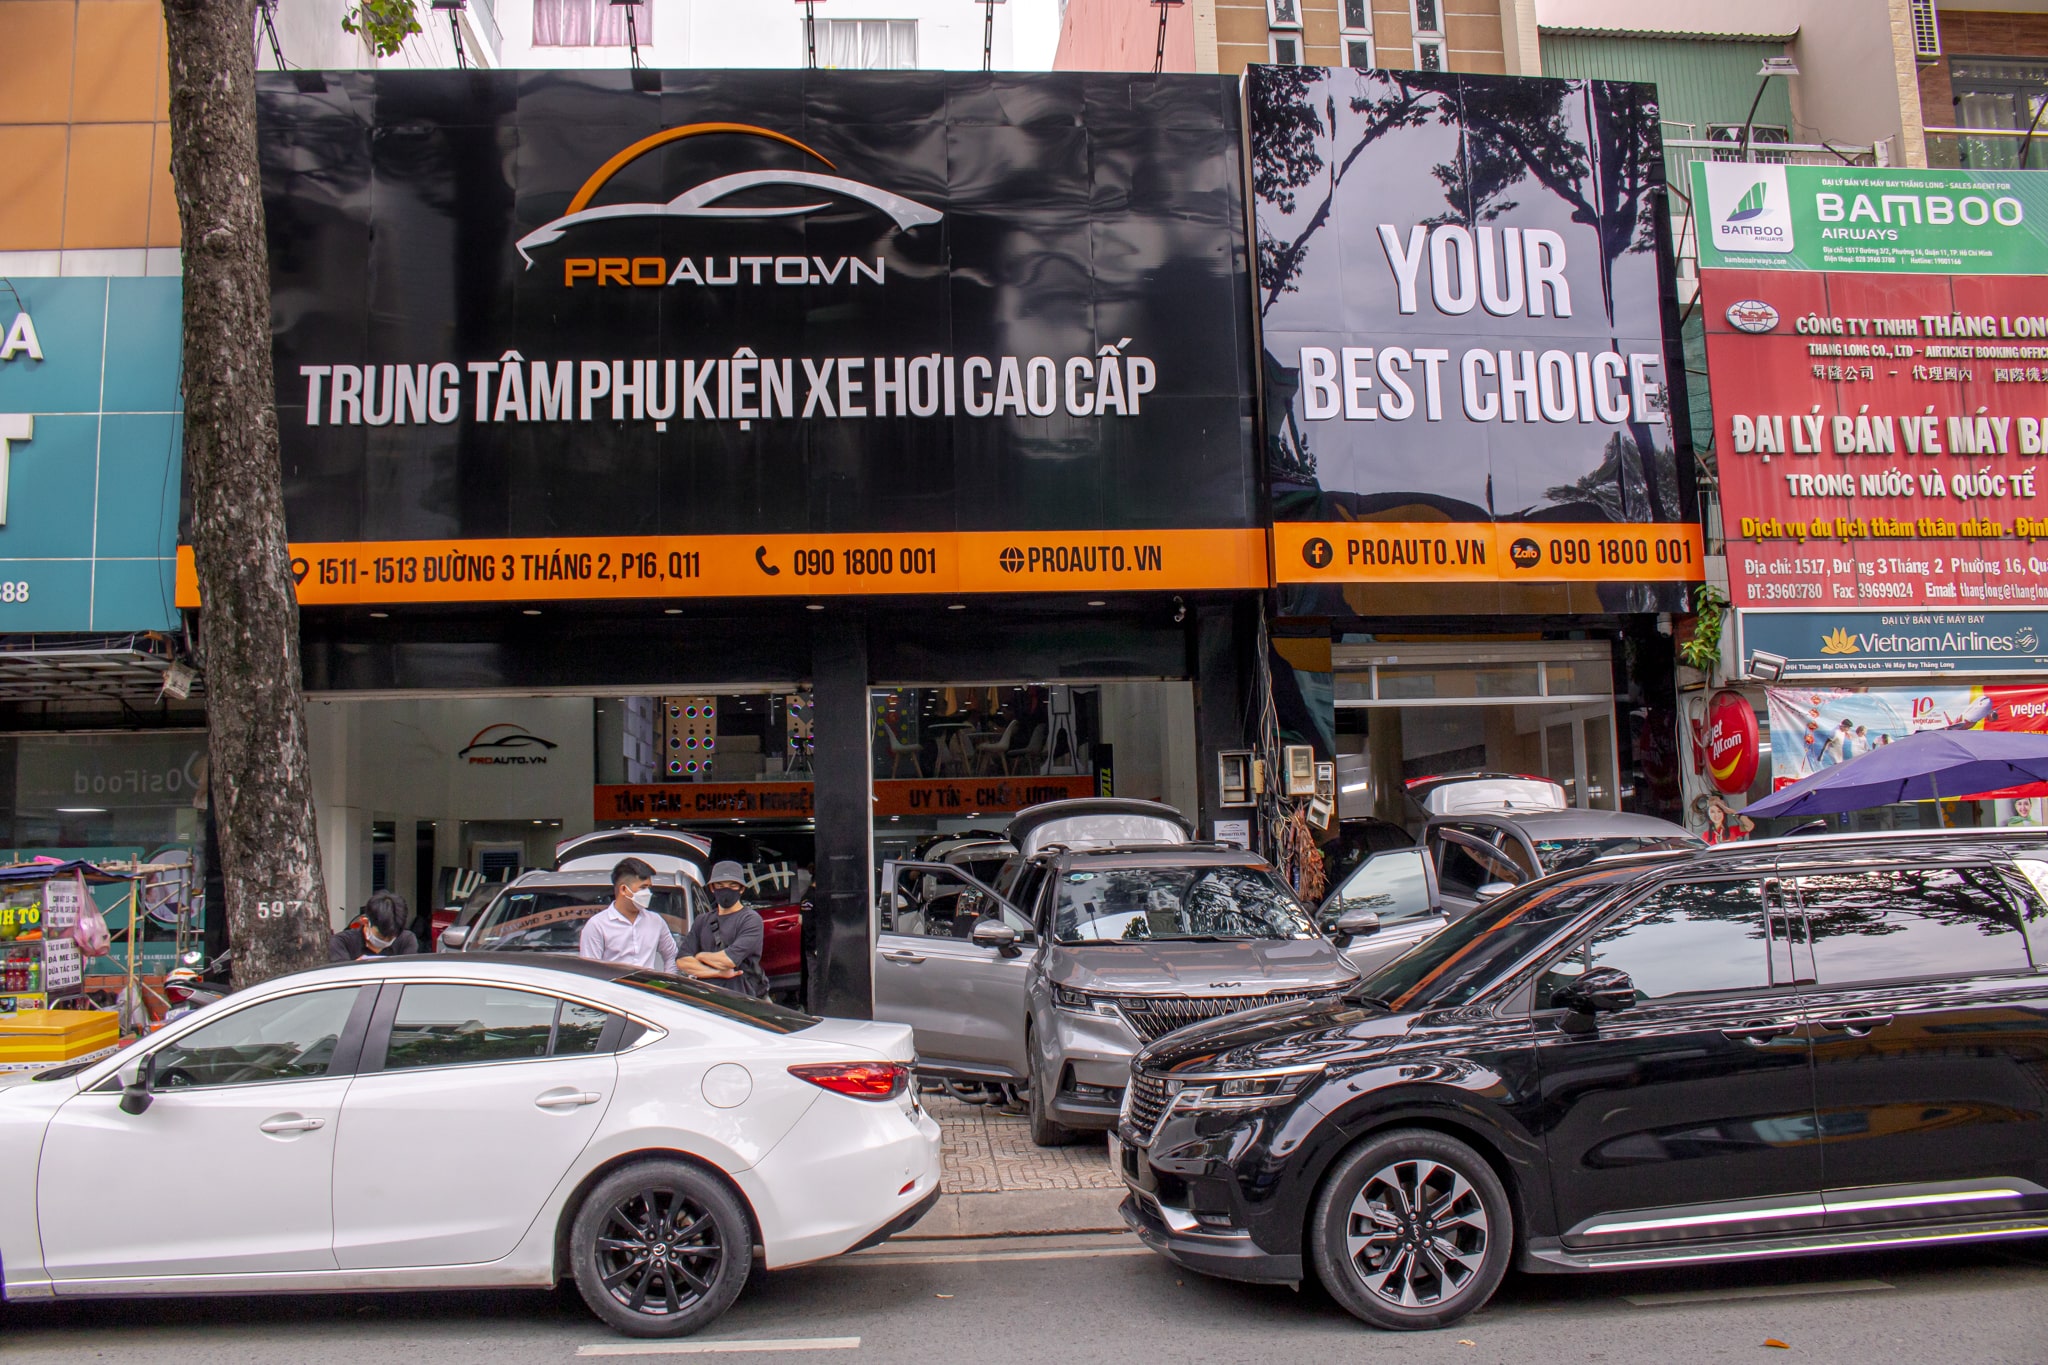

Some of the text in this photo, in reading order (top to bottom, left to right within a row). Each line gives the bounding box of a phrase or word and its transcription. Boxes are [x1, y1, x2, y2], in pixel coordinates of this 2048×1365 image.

[1835, 177, 1844, 187] LÝ
[1844, 178, 1859, 187] BÁN
[1860, 178, 1869, 187] VÉ
[1870, 178, 1885, 188] MÁY
[1886, 180, 1900, 188] BAY
[1925, 181, 1944, 190] LONG
[1949, 182, 1972, 190] SALES
[1972, 182, 1996, 190] AGENT
[1816, 193, 2023, 227] BAMBOO
[1721, 225, 1783, 236] BAMBOO
[1821, 228, 1898, 241] AIRWAYS
[565, 256, 885, 287] PROAUTO.VN
[1376, 224, 1572, 318] YOUR
[1724, 256, 1787, 265] bambooairways.com
[0, 312, 43, 361] A
[1795, 311, 2048, 338] CÔNG TY TNHH THĂNG LON
[1808, 343, 2048, 359] THANG LONG CO., LTD AIRTICKET BOOKING OFFIC
[299, 337, 1157, 433] TRUNG TÂM PHỤ KIỆN XE HƠI CAO CẤP
[1300, 346, 1665, 424] BEST CHOICE
[1732, 414, 1785, 463] ĐẠI
[1790, 403, 1825, 455] LÝ
[1831, 403, 1896, 455] BÁN
[1899, 403, 1943, 455] VÉ
[1947, 405, 2011, 455] MÁY
[1786, 465, 2037, 500] TRONG NƯỚC VÀ QUỐC TẾ
[1741, 517, 1782, 543] Dịch
[1784, 521, 1807, 543] vụ
[1810, 517, 1832, 537] du
[1836, 517, 1868, 543] lịch
[1871, 517, 1915, 538] thăm
[1918, 517, 1957, 538] thân
[1961, 517, 2002, 538] nhân
[794, 547, 937, 576] 090 1800 001
[1028, 545, 1162, 572] PROAUTO.VN
[1347, 540, 1486, 566] PROAUTO.VN
[1513, 539, 1692, 565] Zalo 090 1800 001
[317, 558, 357, 585] 1511
[374, 556, 417, 585] 1513
[423, 549, 495, 583] ĐƯỜNG
[501, 555, 515, 581] 3
[521, 549, 592, 581] THÁNG
[597, 554, 617, 583] 2,
[669, 551, 700, 579] Q11
[1744, 558, 1767, 578] Địa
[1769, 557, 1792, 575] chỉ:
[1877, 558, 1888, 574] 3
[1890, 558, 1930, 576] Tháng
[1934, 557, 1944, 574] 2
[1951, 557, 2001, 575] Phường
[2004, 558, 2027, 576] 16,
[2028, 556, 2048, 576] Qu
[0, 581, 29, 603] 88
[1858, 582, 1914, 598] 39699024
[1882, 613, 1985, 626] ĐẠI LÝ BÁN VÉ MÁY BAY
[1940, 661, 1955, 670] Long
[1911, 696, 1935, 718] 10
[469, 757, 547, 765] PROAUTO.VN
[615, 790, 645, 816] TẬN
[648, 790, 682, 813] TÂM
[909, 788, 933, 808] UY
[936, 784, 961, 808] TÍN
[17, 900, 41, 925] TỐ
[59, 953, 70, 962] ME
